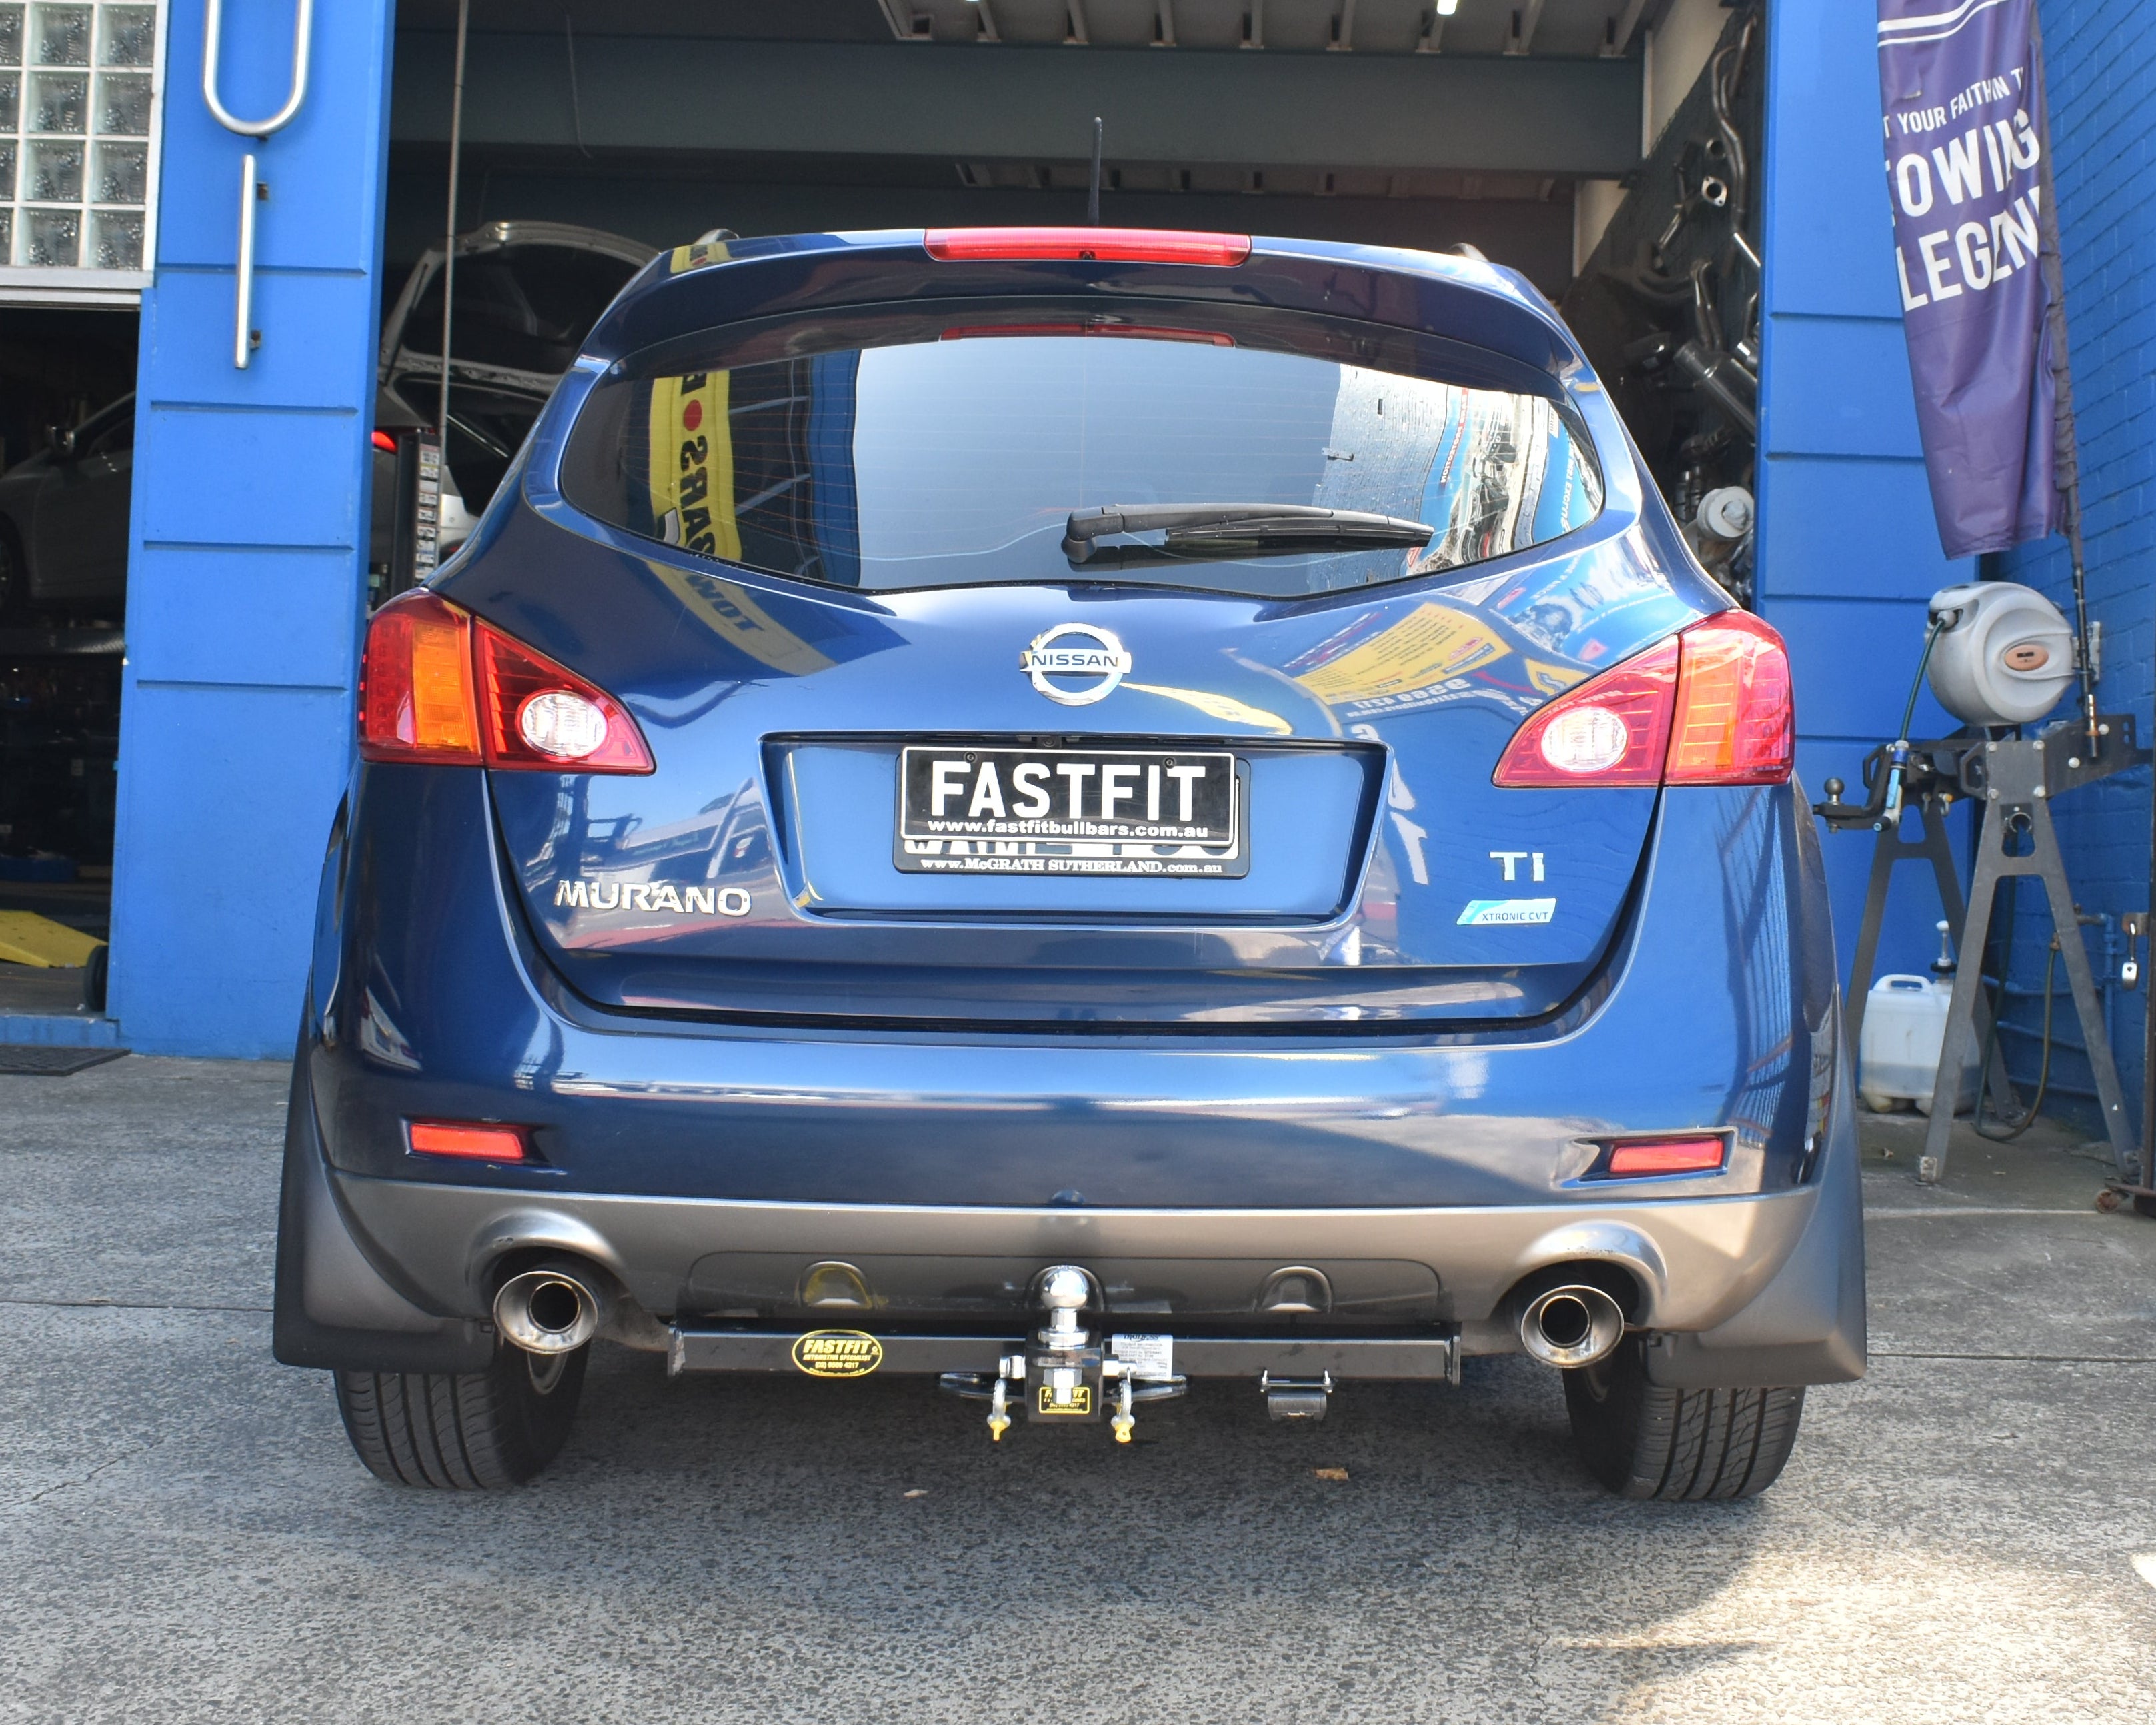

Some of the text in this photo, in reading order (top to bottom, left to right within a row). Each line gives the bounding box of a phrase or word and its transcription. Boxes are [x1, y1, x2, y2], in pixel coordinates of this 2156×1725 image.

[1897, 106, 1947, 134] YOUR
[1032, 654, 1118, 667] NISSAN
[932, 761, 1206, 821] FASTFIT
[927, 819, 1208, 838] www.fastfitbullbars.com.au
[920, 857, 1223, 874] www.McGRATH SUTHERLAND.com.au
[553, 880, 752, 917] MURANO
[1482, 911, 1549, 921] XTRONIC CVT
[803, 1339, 872, 1354] FASTFIT
